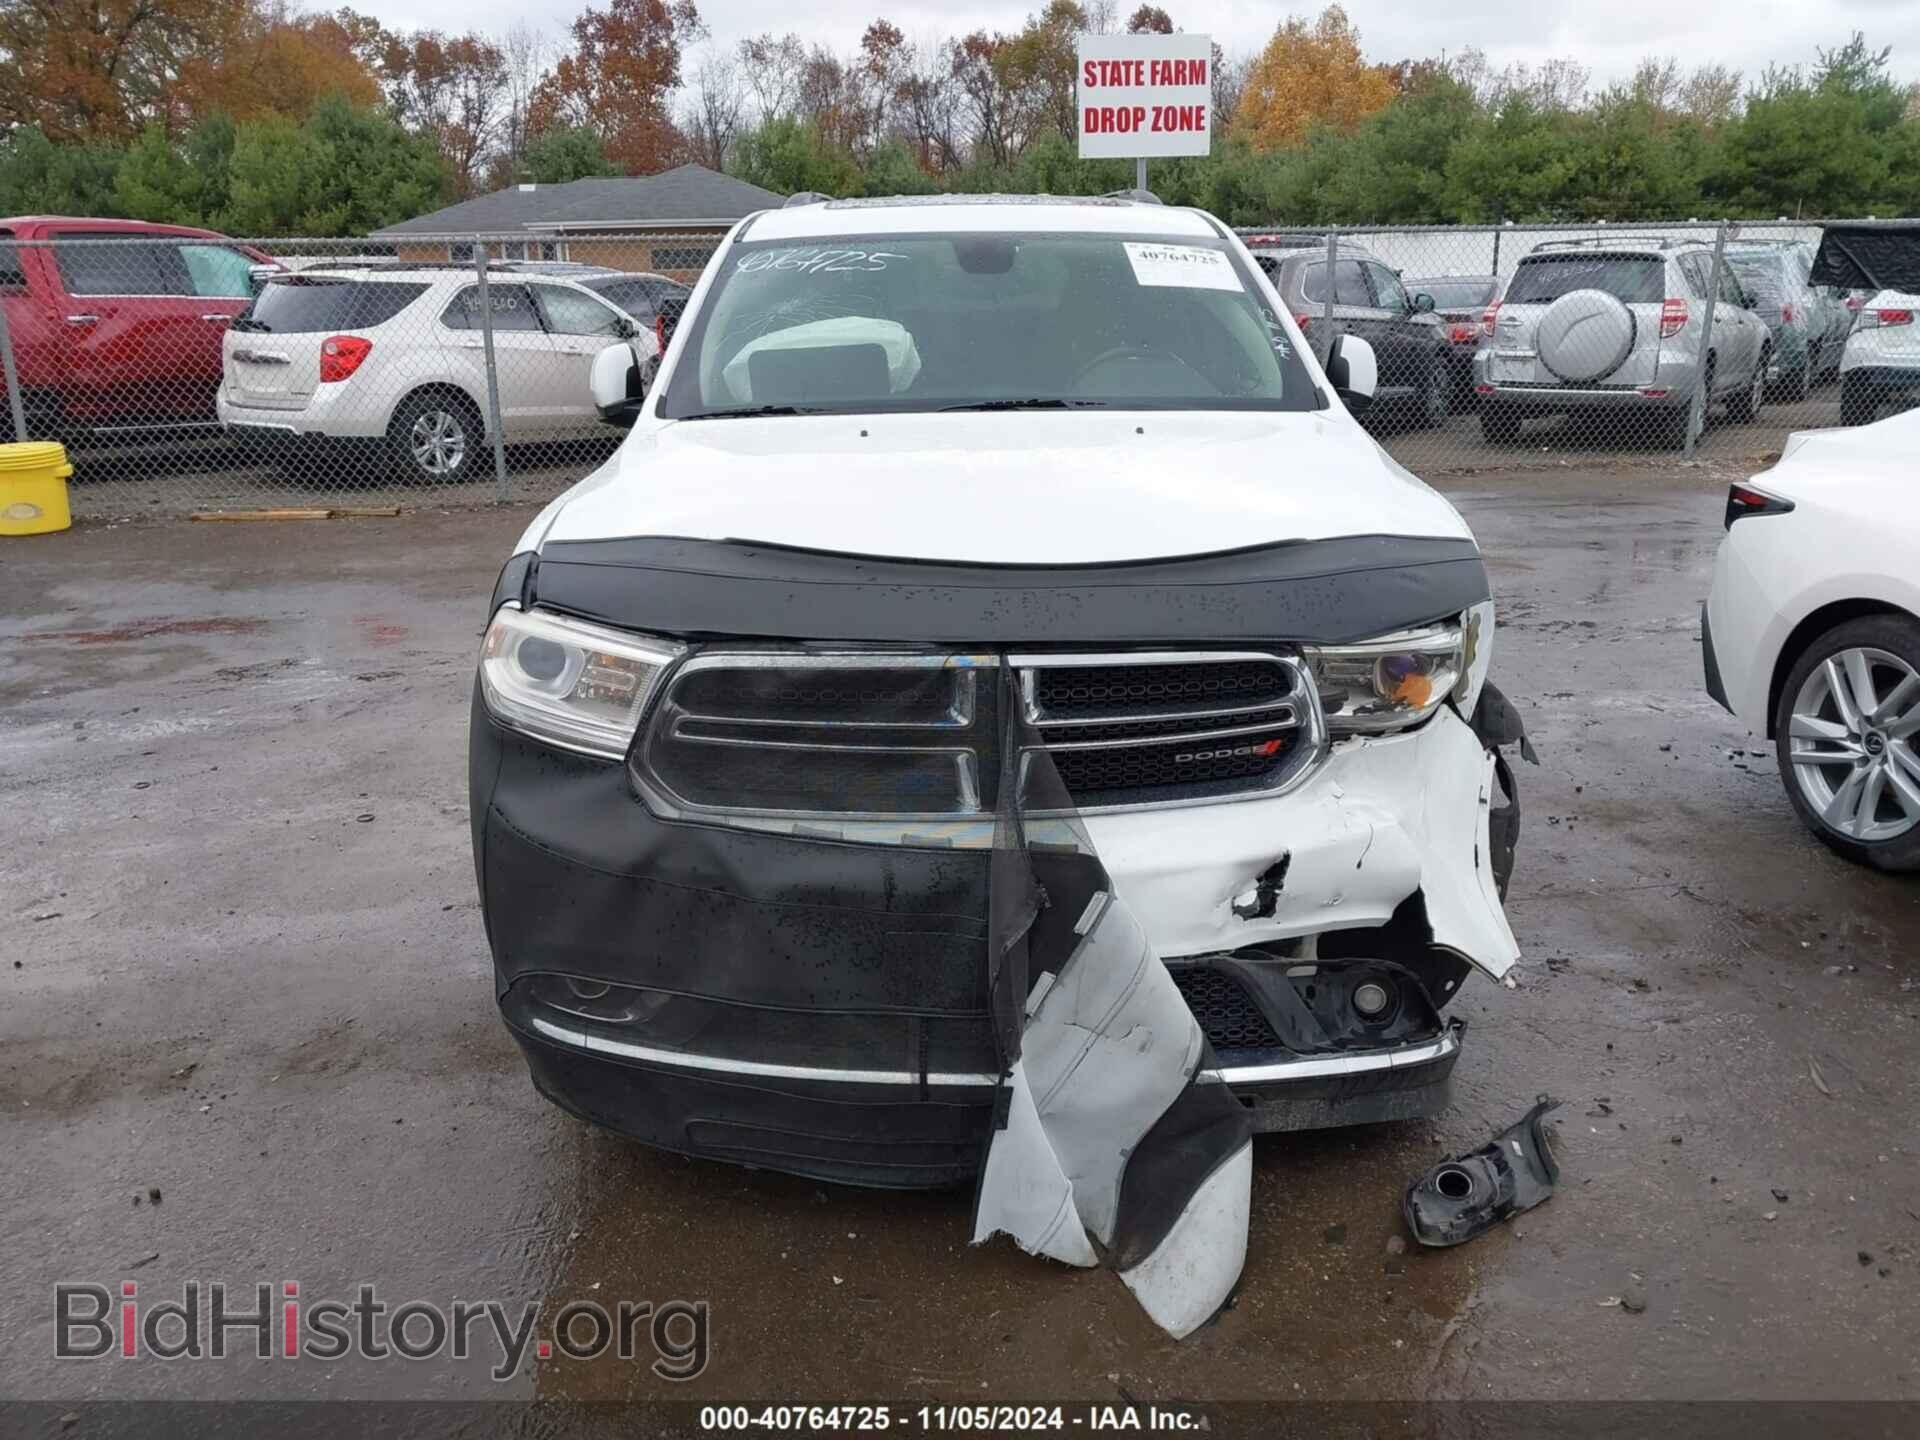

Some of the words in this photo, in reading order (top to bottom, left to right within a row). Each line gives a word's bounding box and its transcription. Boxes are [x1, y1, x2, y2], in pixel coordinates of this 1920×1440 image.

[1084, 60, 1145, 87] STATE
[1150, 59, 1206, 86] FARM
[1084, 107, 1146, 133] DROP
[1151, 105, 1205, 132] ZONE
[1138, 250, 1220, 266] 40764725
[1175, 745, 1265, 762] DODGE
